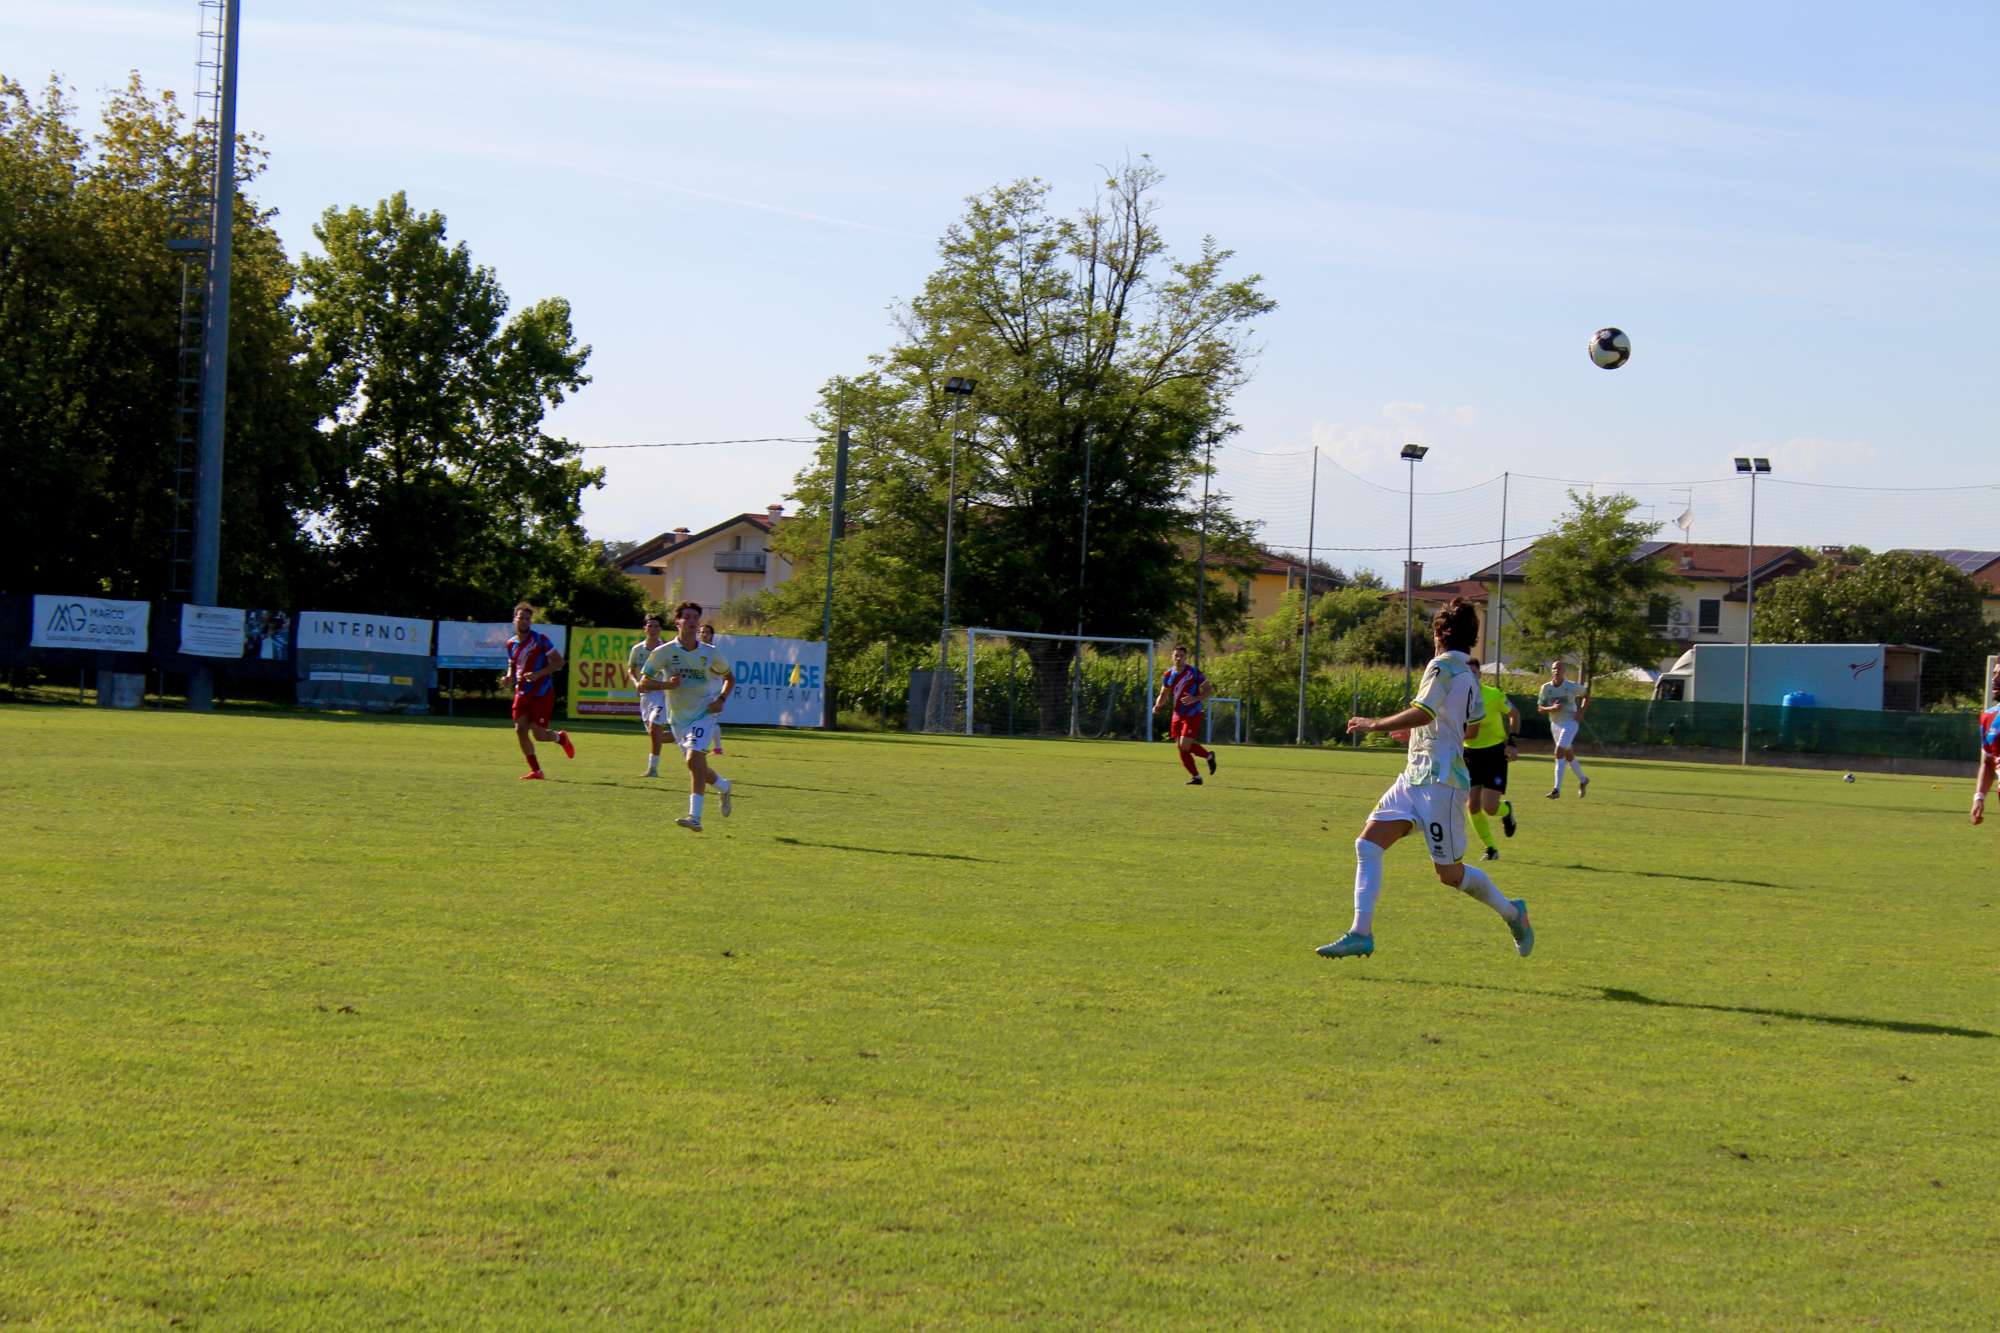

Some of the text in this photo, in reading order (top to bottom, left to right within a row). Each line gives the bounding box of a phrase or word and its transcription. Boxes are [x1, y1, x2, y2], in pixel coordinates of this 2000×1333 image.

[735, 660, 821, 689] DAINESE
[691, 726, 705, 738] 10
[1430, 822, 1443, 843] 9
